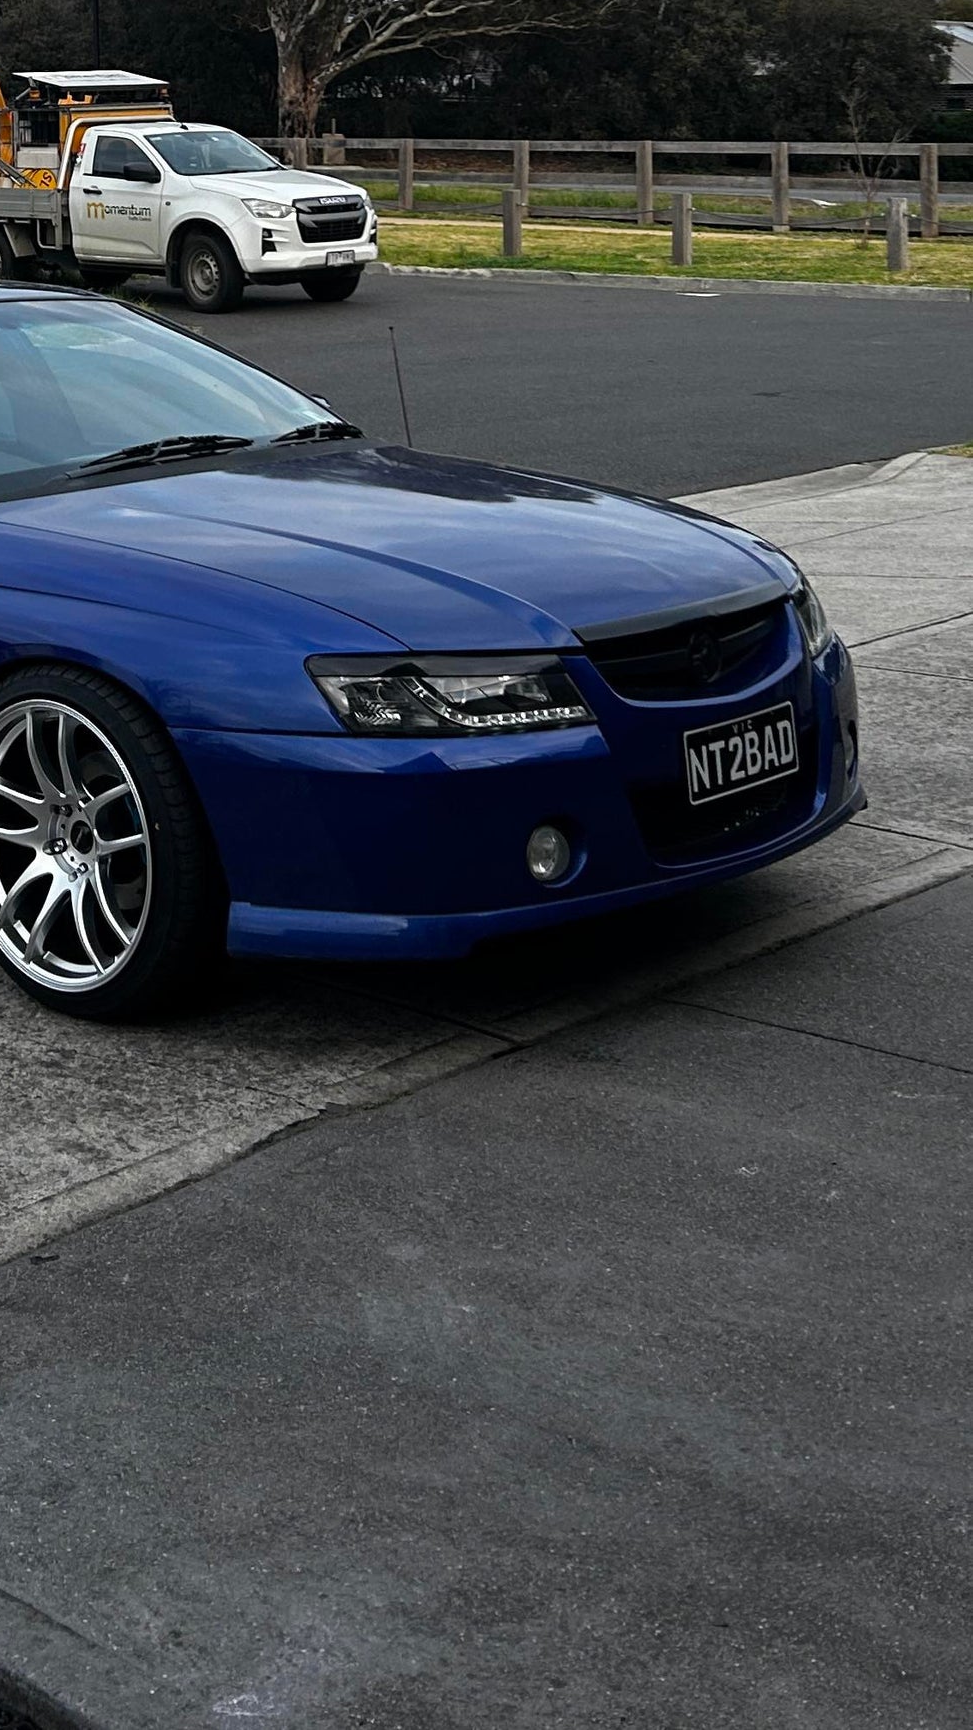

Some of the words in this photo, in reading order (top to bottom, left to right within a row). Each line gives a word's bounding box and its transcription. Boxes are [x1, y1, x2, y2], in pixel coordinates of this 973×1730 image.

[39, 172, 53, 187] SL
[319, 196, 346, 205] ISUZU
[731, 719, 753, 734] VIC
[689, 720, 795, 793] NT2BAD
